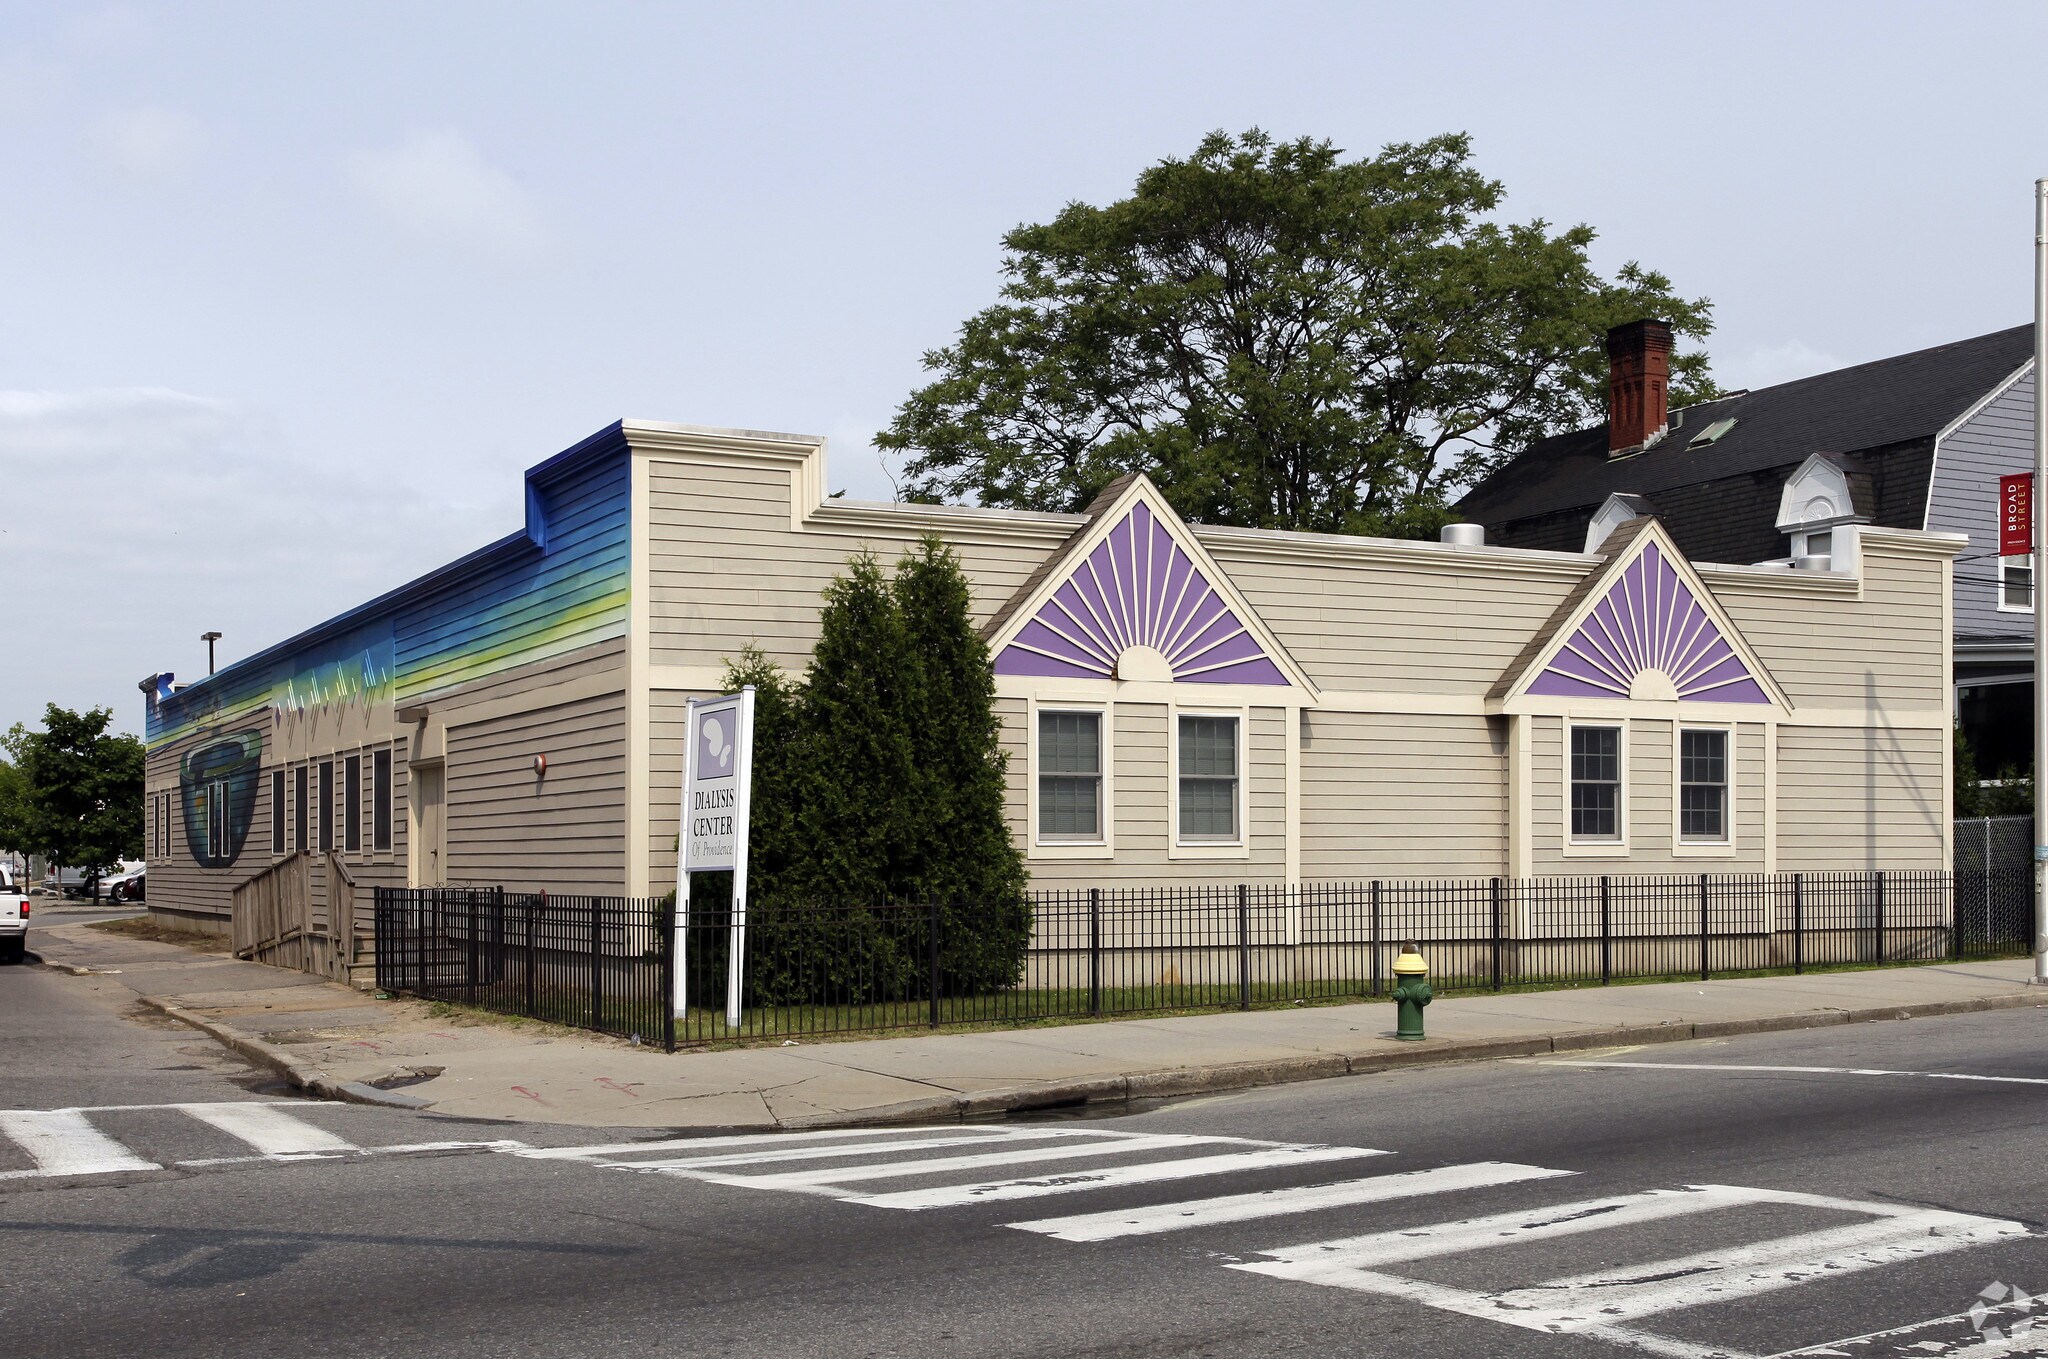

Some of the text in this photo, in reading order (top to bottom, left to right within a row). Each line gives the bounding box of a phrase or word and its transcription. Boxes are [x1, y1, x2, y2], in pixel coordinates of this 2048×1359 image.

[2008, 484, 2017, 531] BROAD
[2018, 484, 2026, 530] STREET
[695, 788, 734, 810] DIALYSIS
[693, 816, 732, 837] CENTER
[692, 840, 733, 860] Of Providence
